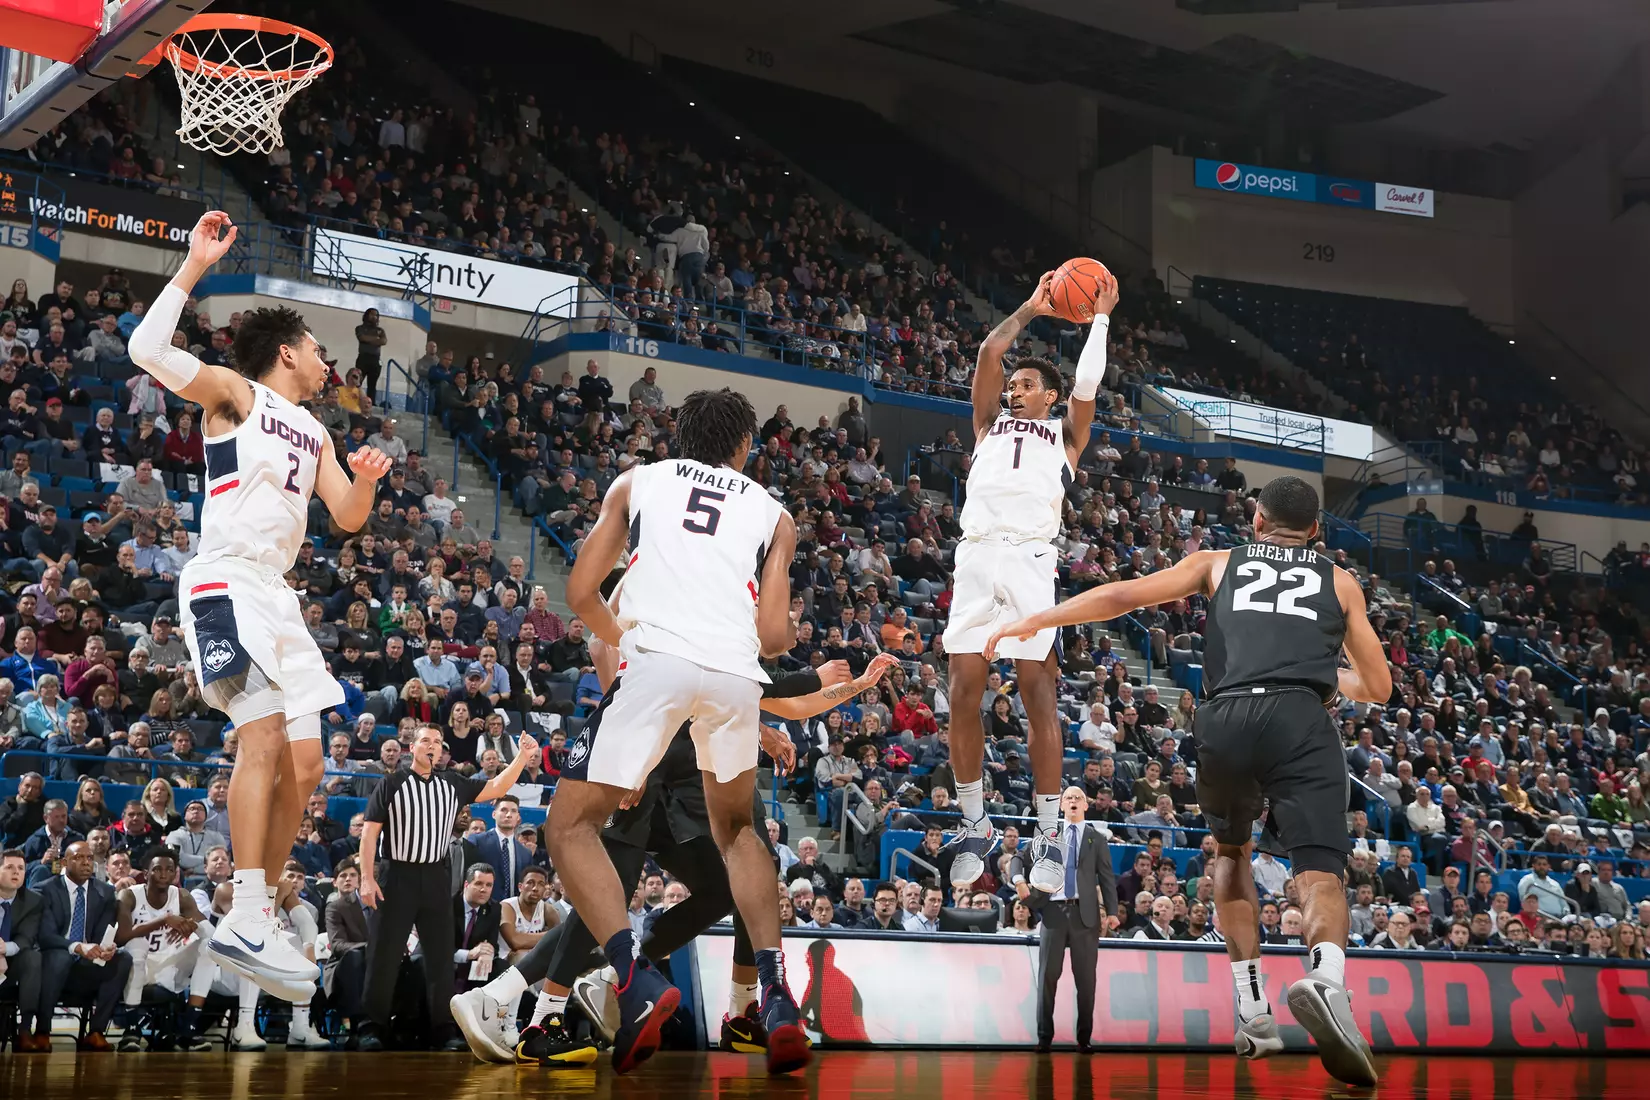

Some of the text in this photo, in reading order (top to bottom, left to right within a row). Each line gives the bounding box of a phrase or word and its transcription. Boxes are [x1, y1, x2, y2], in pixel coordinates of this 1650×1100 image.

[1245, 173, 1298, 193] pepsi
[1303, 243, 1335, 263] 219
[626, 337, 659, 357] 116
[989, 419, 1057, 446] UCONN
[1288, 417, 1305, 430] local
[1307, 423, 1334, 434] docors
[1012, 437, 1024, 470] 1
[284, 452, 301, 495] 2
[676, 463, 750, 495] WHALEY
[682, 487, 726, 536] 5
[1247, 543, 1317, 564] GREEN JR
[1232, 560, 1322, 621] 22
[1510, 965, 1588, 1049] &
